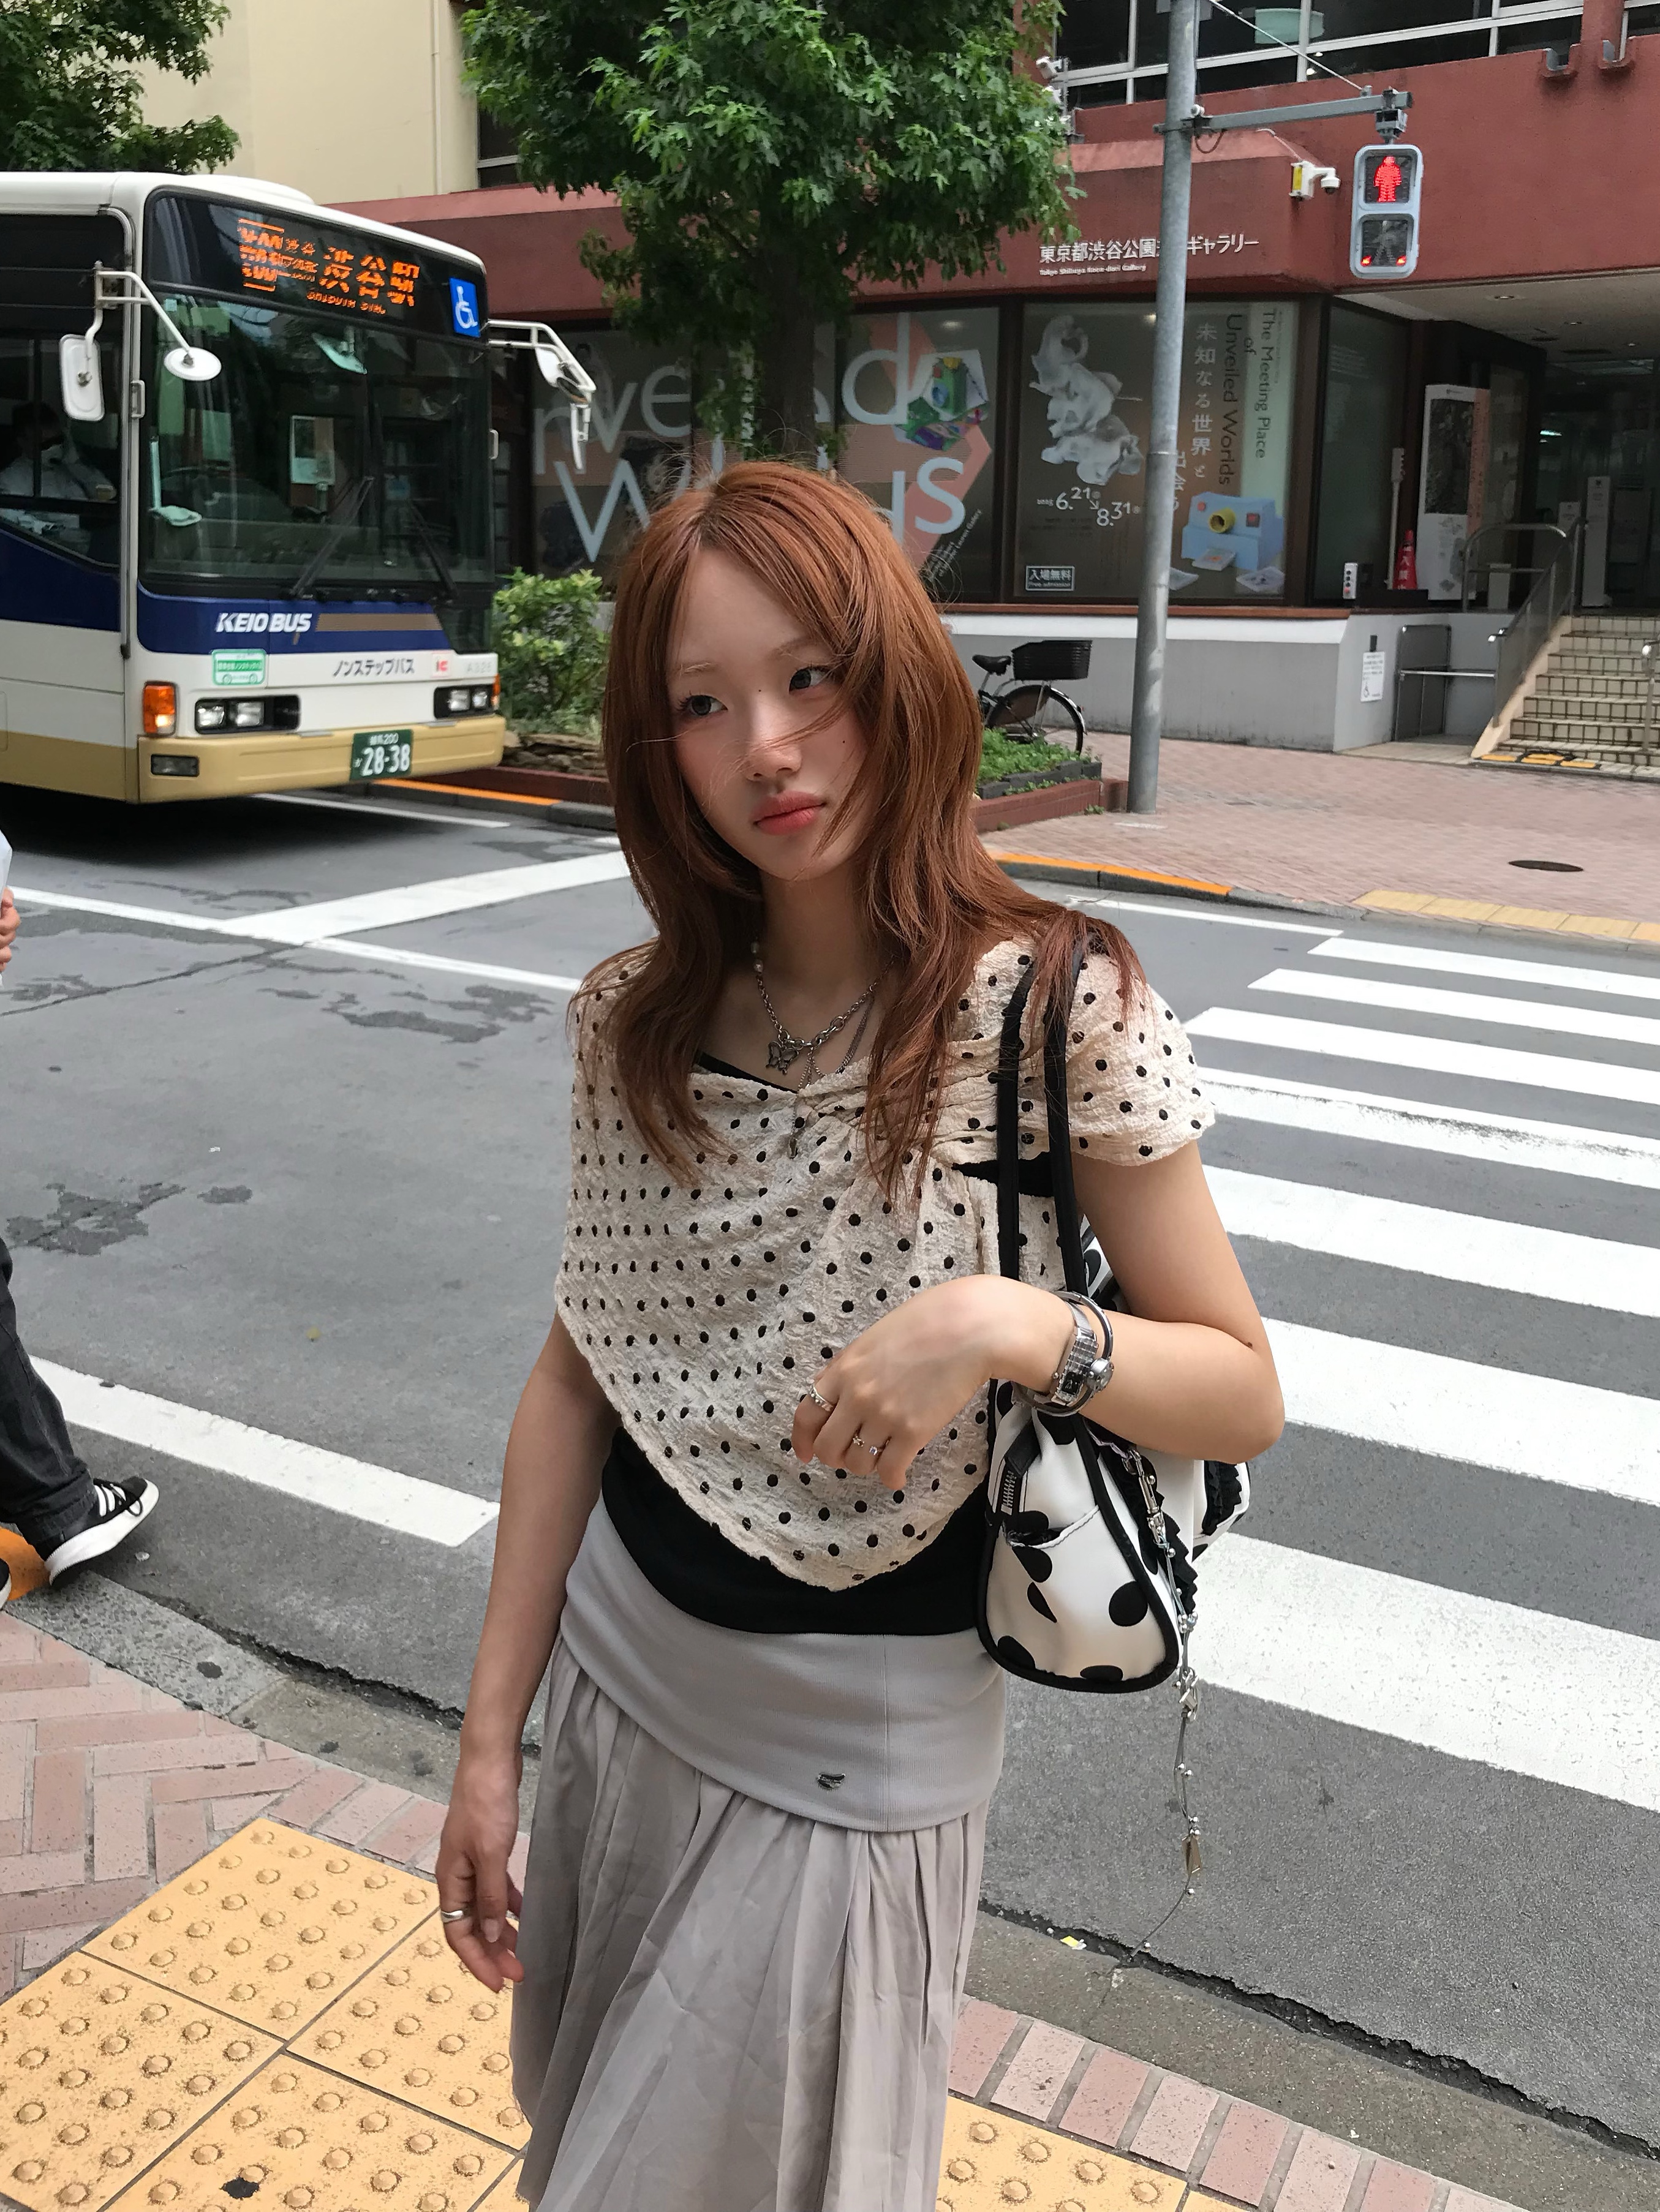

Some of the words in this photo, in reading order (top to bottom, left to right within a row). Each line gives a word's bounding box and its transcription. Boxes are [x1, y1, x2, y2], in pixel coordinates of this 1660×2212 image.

[1261, 311, 1276, 340] The
[1223, 314, 1242, 402] Unveiled
[1244, 337, 1256, 356] of
[1254, 347, 1274, 412] Meeting
[1190, 323, 1217, 478] 未知なる世界と
[1219, 410, 1238, 486] Worlds
[1255, 417, 1271, 458] Place
[216, 612, 269, 633] KEIO
[268, 612, 312, 633] BUS
[333, 658, 415, 677] ノンステップバス
[360, 743, 410, 777] 28-38
